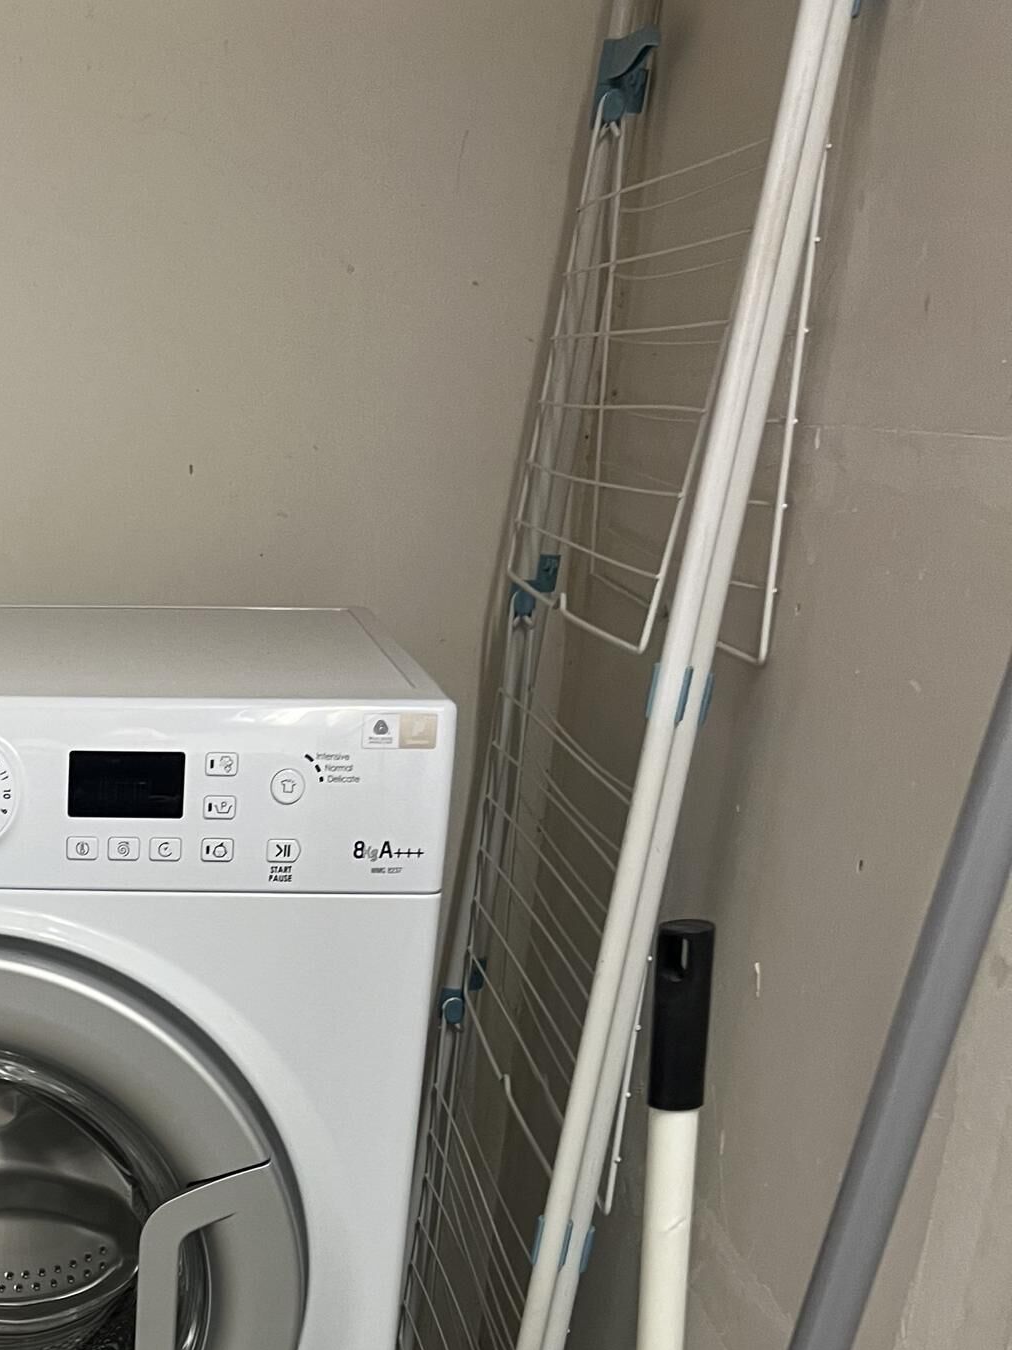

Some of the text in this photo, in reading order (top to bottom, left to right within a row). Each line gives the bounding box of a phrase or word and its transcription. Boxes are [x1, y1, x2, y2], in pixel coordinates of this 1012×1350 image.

[0, 770, 9, 781] 11
[3, 789, 11, 800] 10
[270, 865, 292, 874] START
[268, 874, 292, 883] PAUSE
